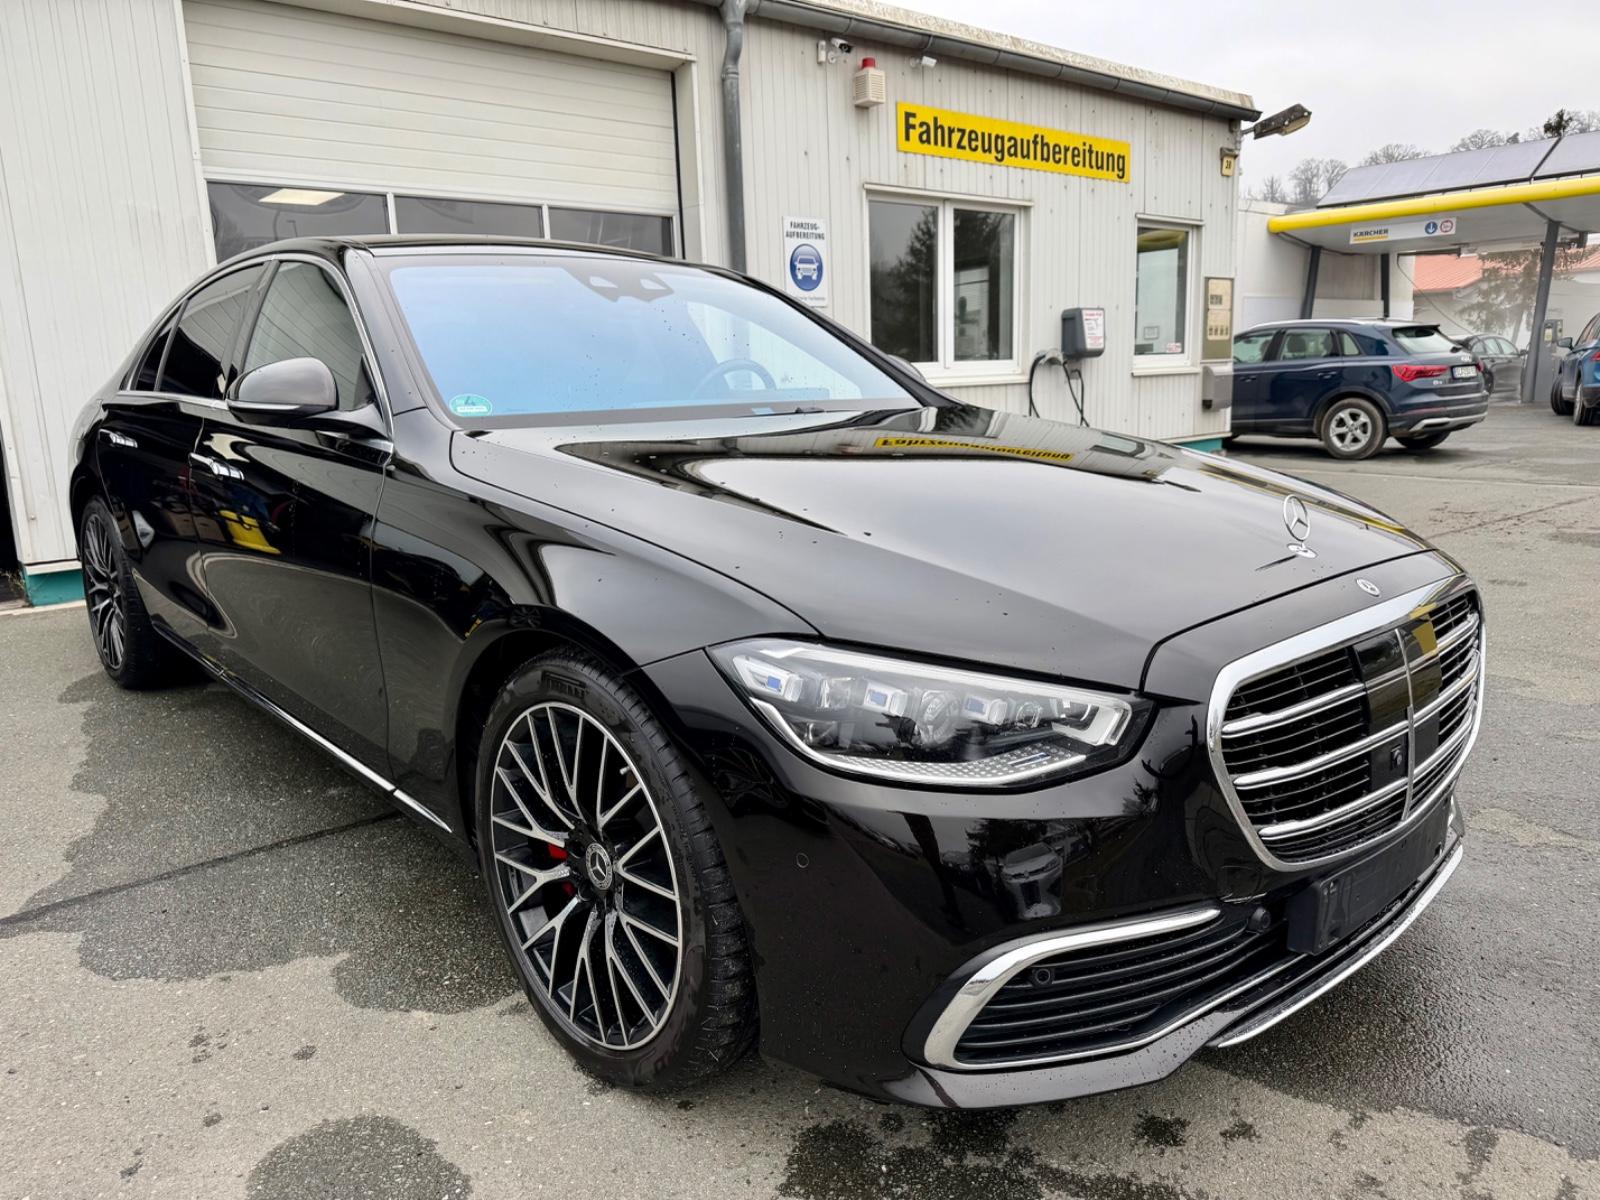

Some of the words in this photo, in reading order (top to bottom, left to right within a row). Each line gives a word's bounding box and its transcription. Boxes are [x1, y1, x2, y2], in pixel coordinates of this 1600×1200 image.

[903, 110, 1126, 180] Fahrzeugaufbereitung
[790, 220, 821, 231] FAHRZEUG-
[785, 230, 826, 241] AUFBEREITUNG
